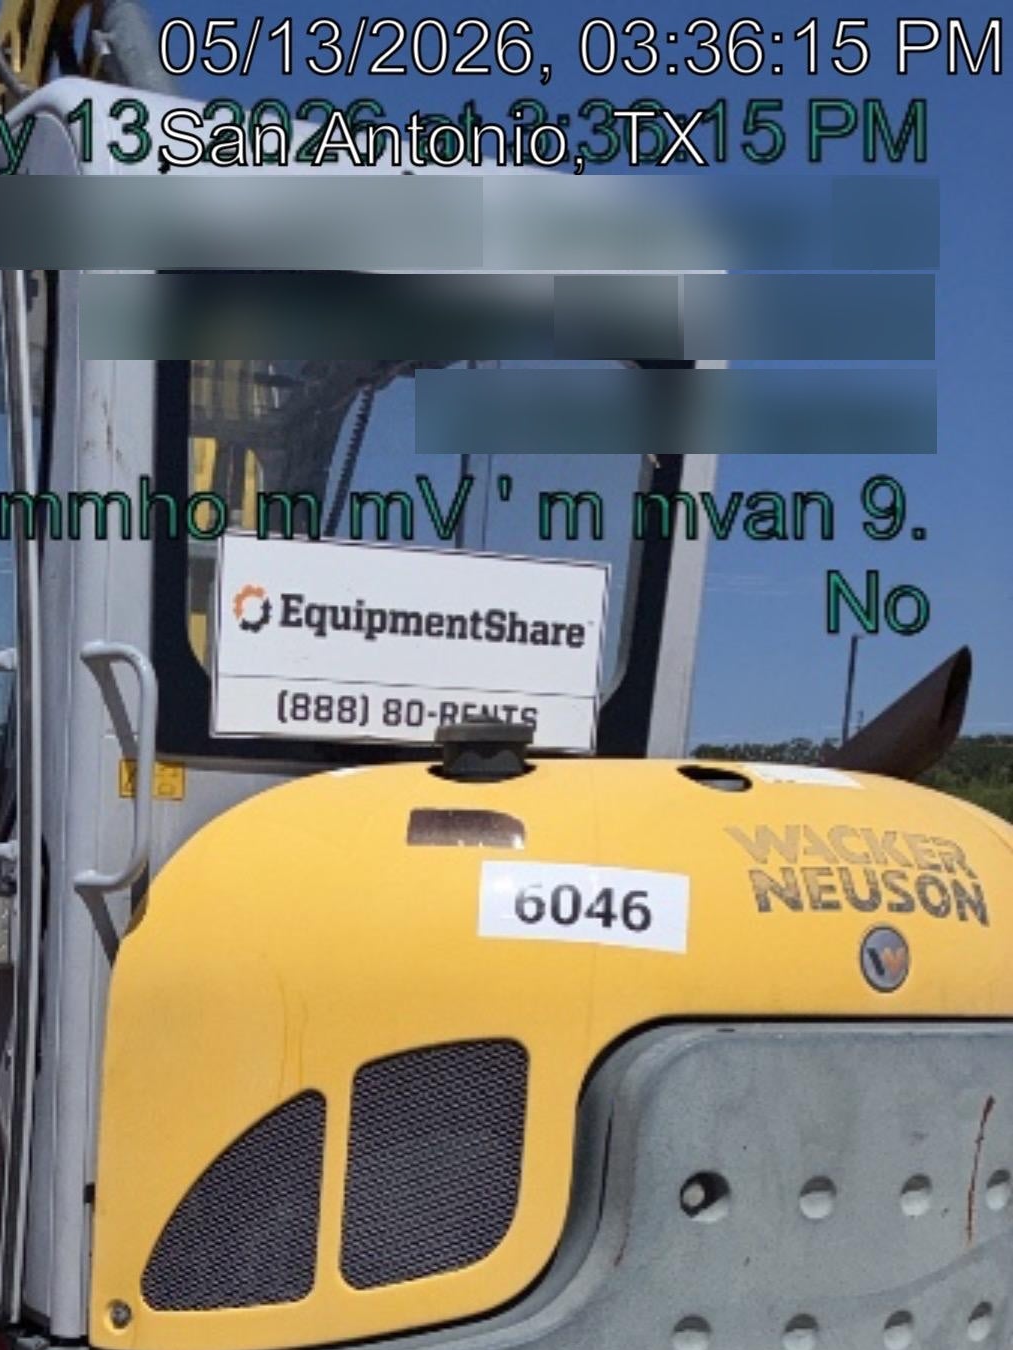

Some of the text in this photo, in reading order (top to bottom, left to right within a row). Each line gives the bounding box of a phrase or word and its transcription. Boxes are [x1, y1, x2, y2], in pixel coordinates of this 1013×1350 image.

[279, 592, 586, 648] EquipmentShare
[277, 690, 369, 727] (888)
[723, 824, 978, 879] WACKER
[514, 884, 652, 933] 6046
[749, 866, 990, 928] NEUSON
